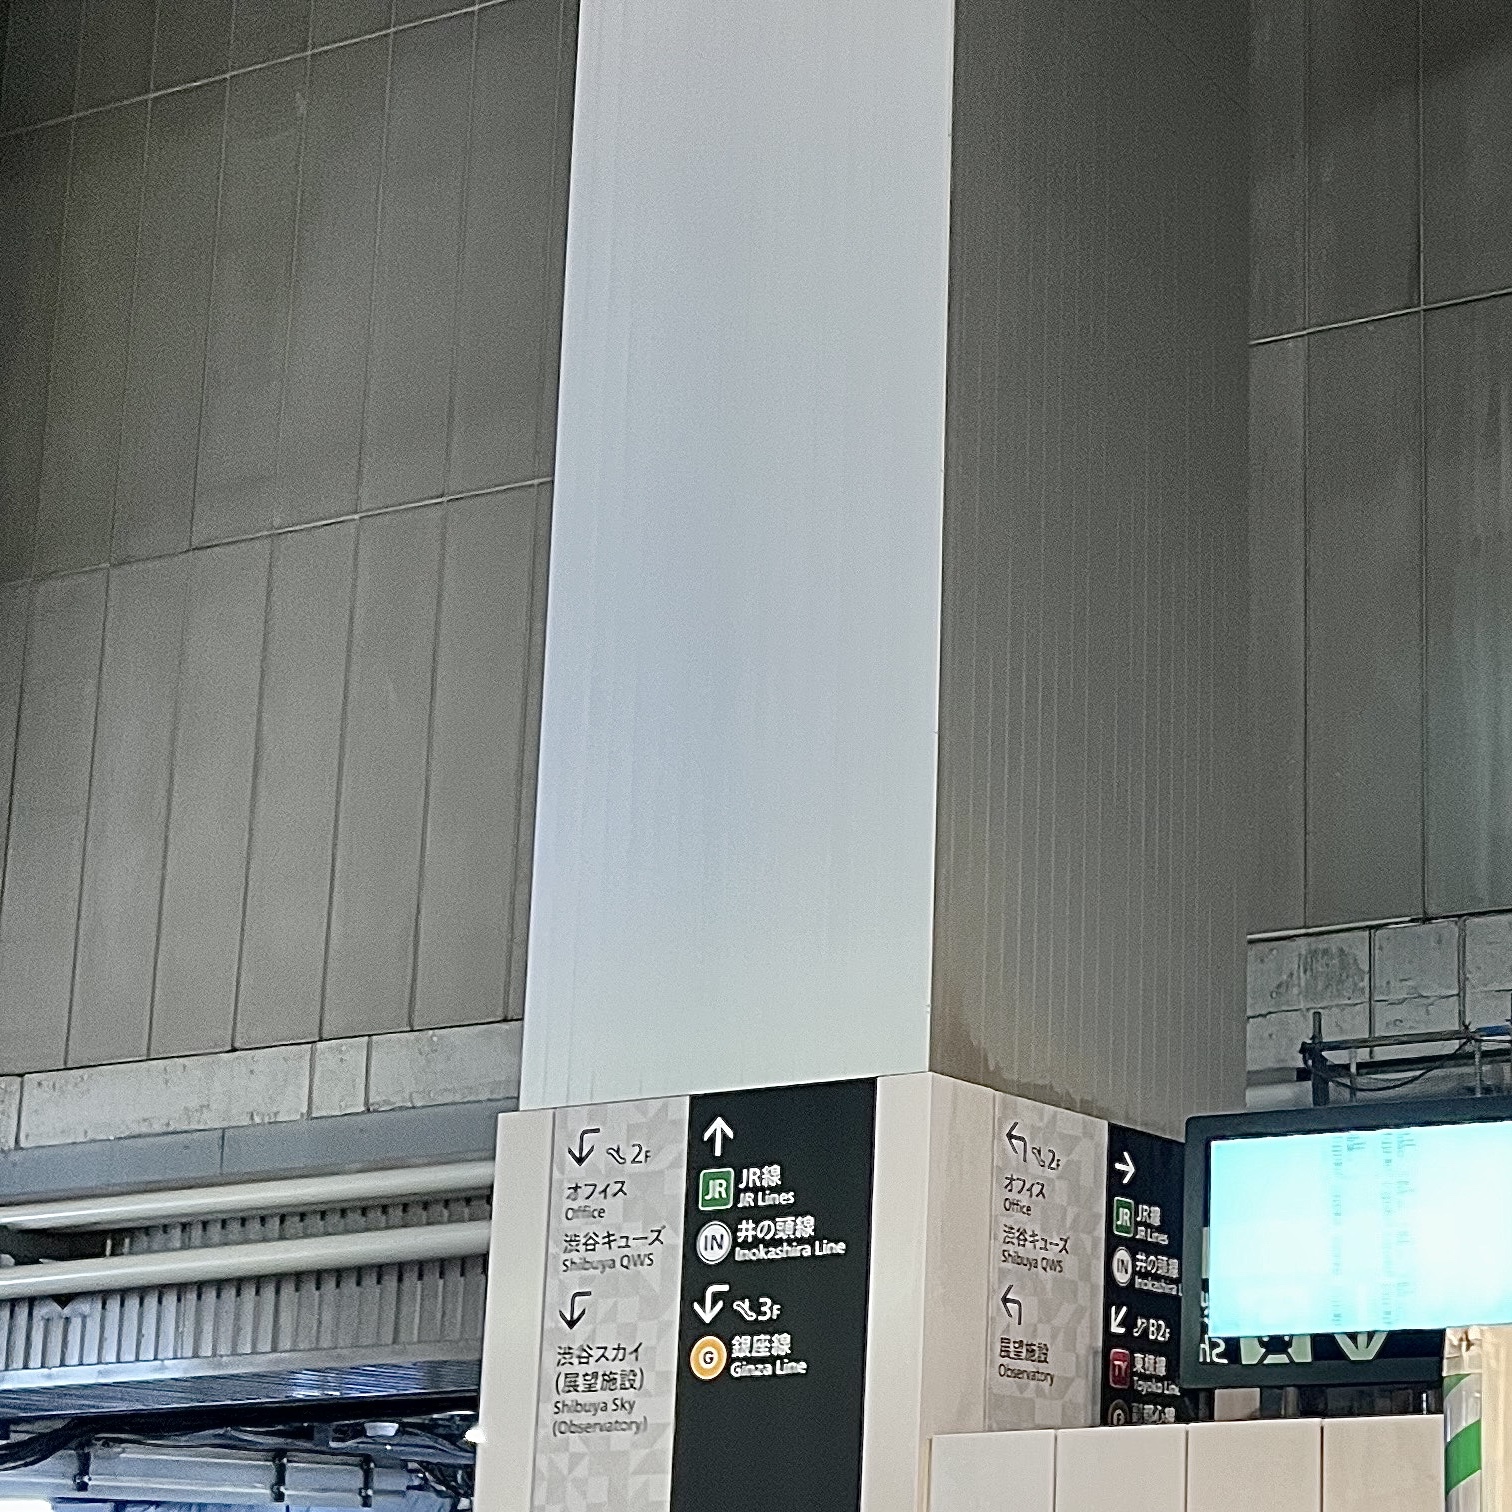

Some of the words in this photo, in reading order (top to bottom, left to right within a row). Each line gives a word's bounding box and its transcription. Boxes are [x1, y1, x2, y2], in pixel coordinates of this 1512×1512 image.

[631, 1143, 651, 1164] 2F
[738, 1164, 782, 1188] JR線
[1004, 1173, 1046, 1200] オフィス
[566, 1180, 627, 1201] オフィス
[704, 1179, 727, 1200] JR
[737, 1193, 755, 1208] JR
[758, 1190, 795, 1206] Lines
[565, 1204, 606, 1221] Office
[1003, 1197, 1032, 1216] Office
[1117, 1207, 1131, 1226] JR
[737, 1214, 815, 1242] 井の頭線
[562, 1225, 667, 1253] 渋谷キューズ
[703, 1233, 724, 1252] IN
[1003, 1224, 1070, 1255] 渋谷キューズ
[735, 1242, 812, 1261] Inokashira
[815, 1240, 846, 1256] Line
[562, 1255, 616, 1273] Shibuya
[620, 1252, 654, 1270] QWS
[1001, 1249, 1038, 1271] Shibuya
[1041, 1257, 1063, 1274] QWS
[758, 1298, 781, 1320] 3F
[1149, 1318, 1170, 1341] B2F
[557, 1342, 643, 1367] 渋谷スカイ
[731, 1333, 791, 1358] 銀座線
[730, 1360, 773, 1378] Ginza
[775, 1359, 807, 1375] Line
[555, 1367, 645, 1395] (展望施設)
[554, 1399, 608, 1416] Shibuya
[611, 1397, 636, 1415] Sky
